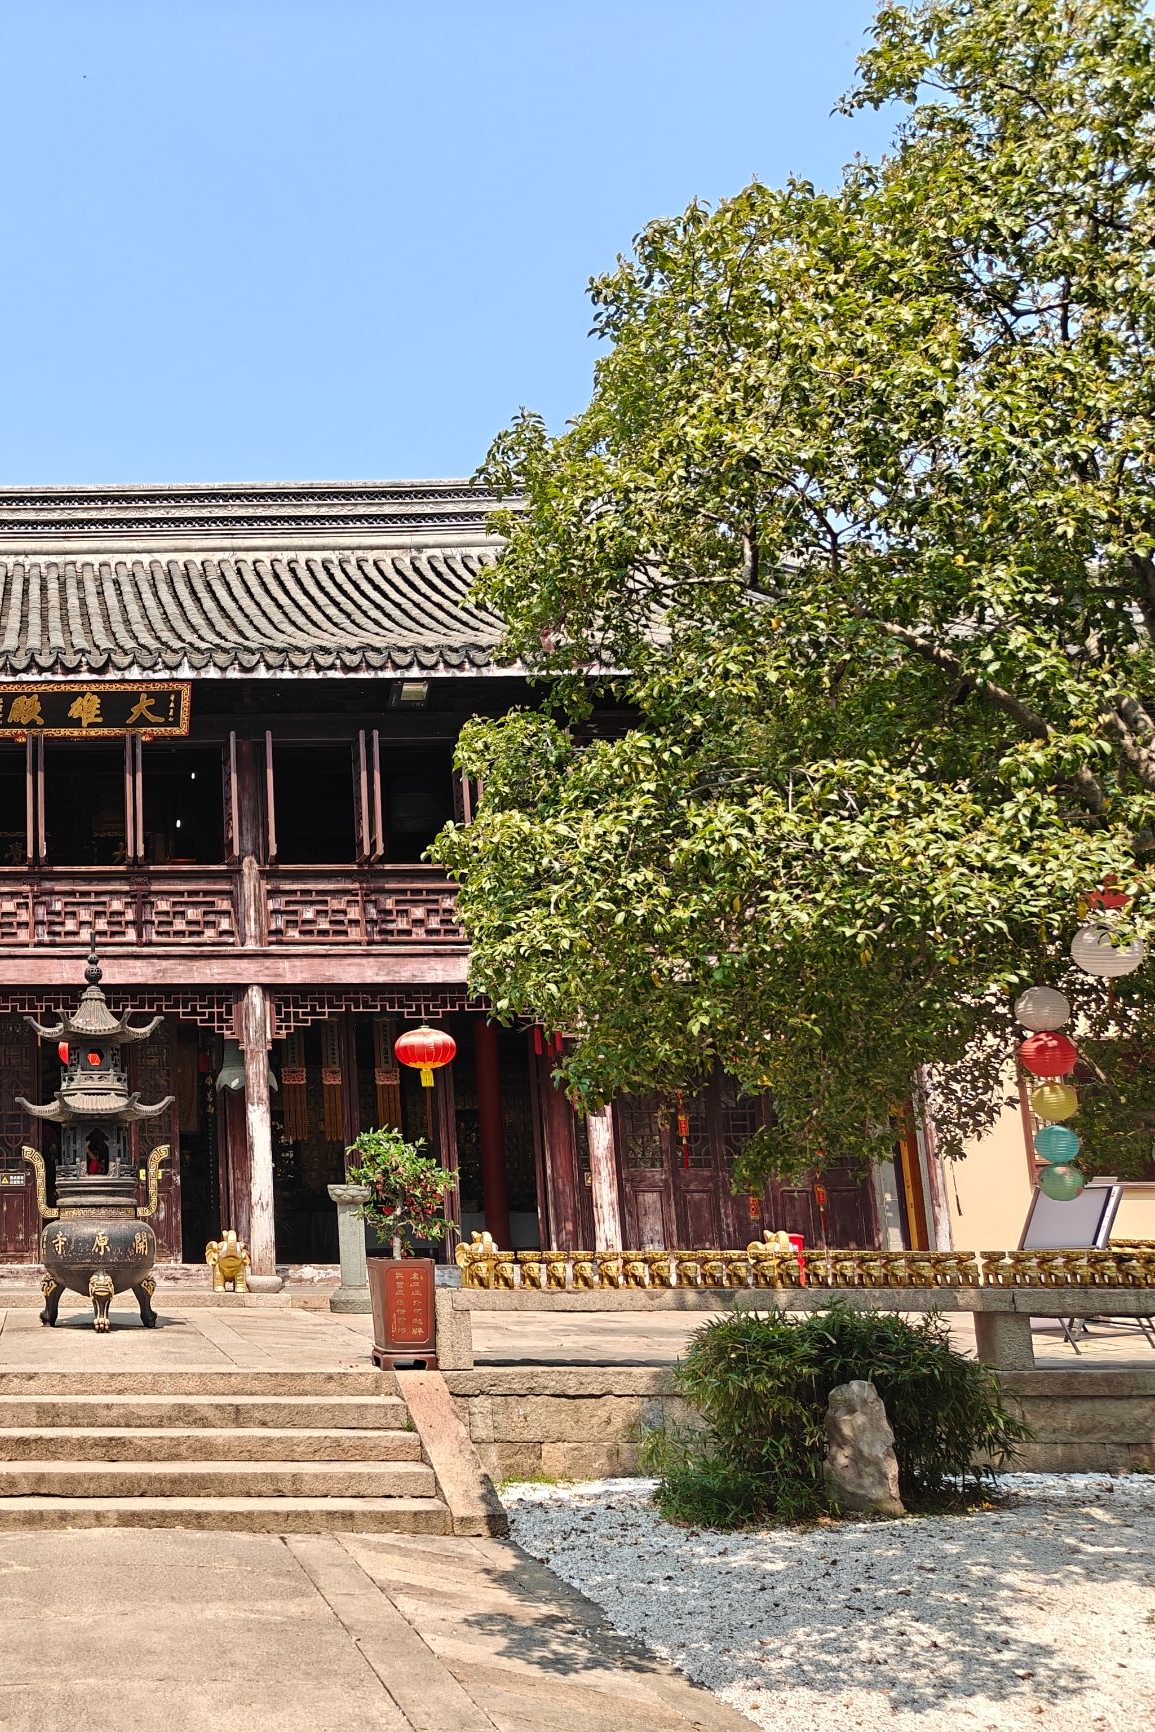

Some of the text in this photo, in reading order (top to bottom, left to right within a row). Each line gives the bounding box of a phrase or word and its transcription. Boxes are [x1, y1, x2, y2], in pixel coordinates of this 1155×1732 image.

[7, 691, 165, 727] 大雄殿
[52, 1231, 148, 1256] 開原寺
